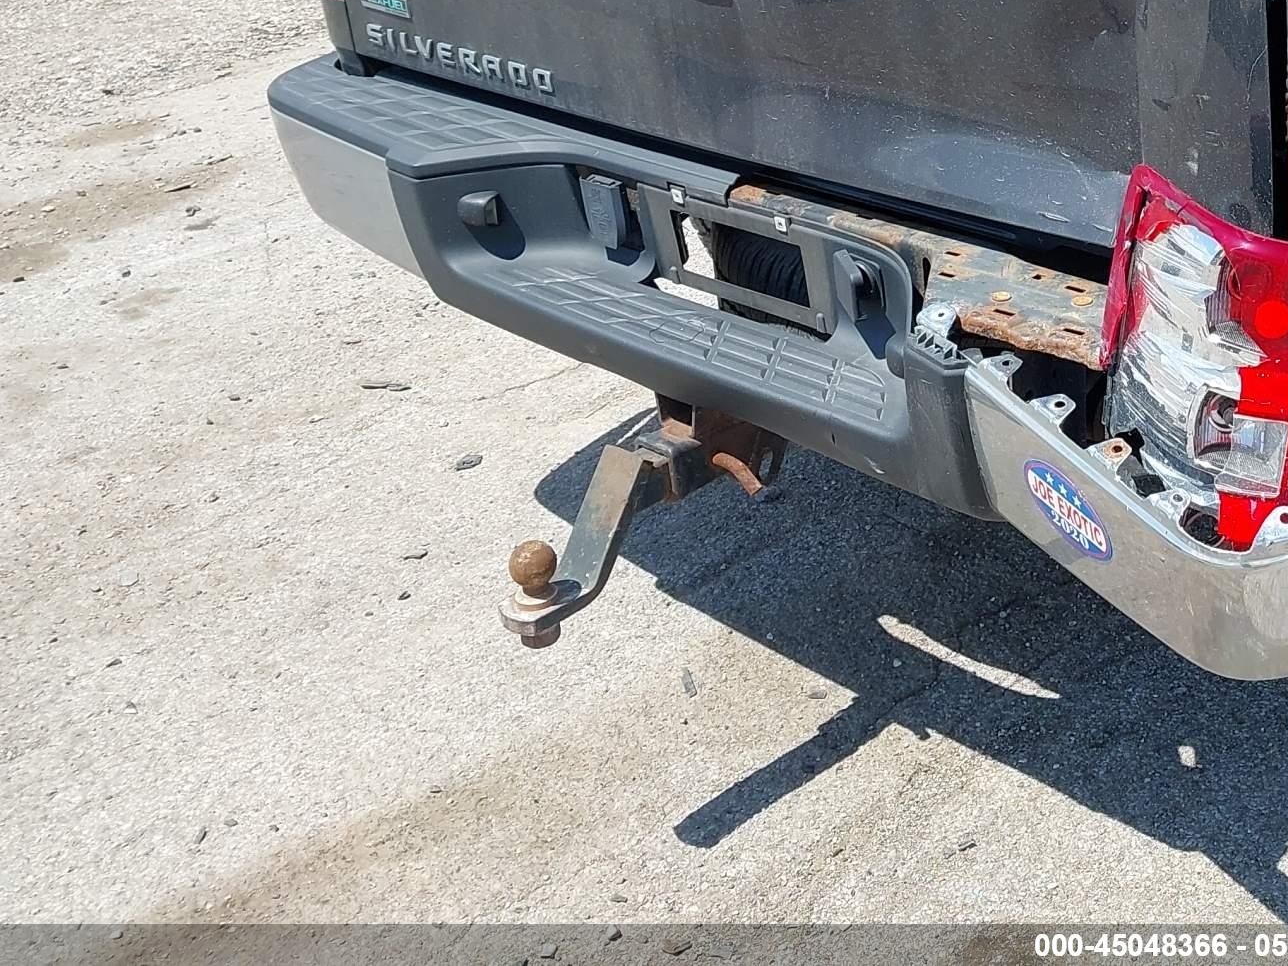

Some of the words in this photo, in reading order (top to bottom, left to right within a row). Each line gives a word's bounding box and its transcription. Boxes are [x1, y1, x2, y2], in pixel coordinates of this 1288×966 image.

[366, 22, 553, 93] SILVERADO
[1032, 475, 1055, 508] JOE
[1057, 495, 1103, 547] EXOTIC
[1050, 509, 1090, 550] 2020
